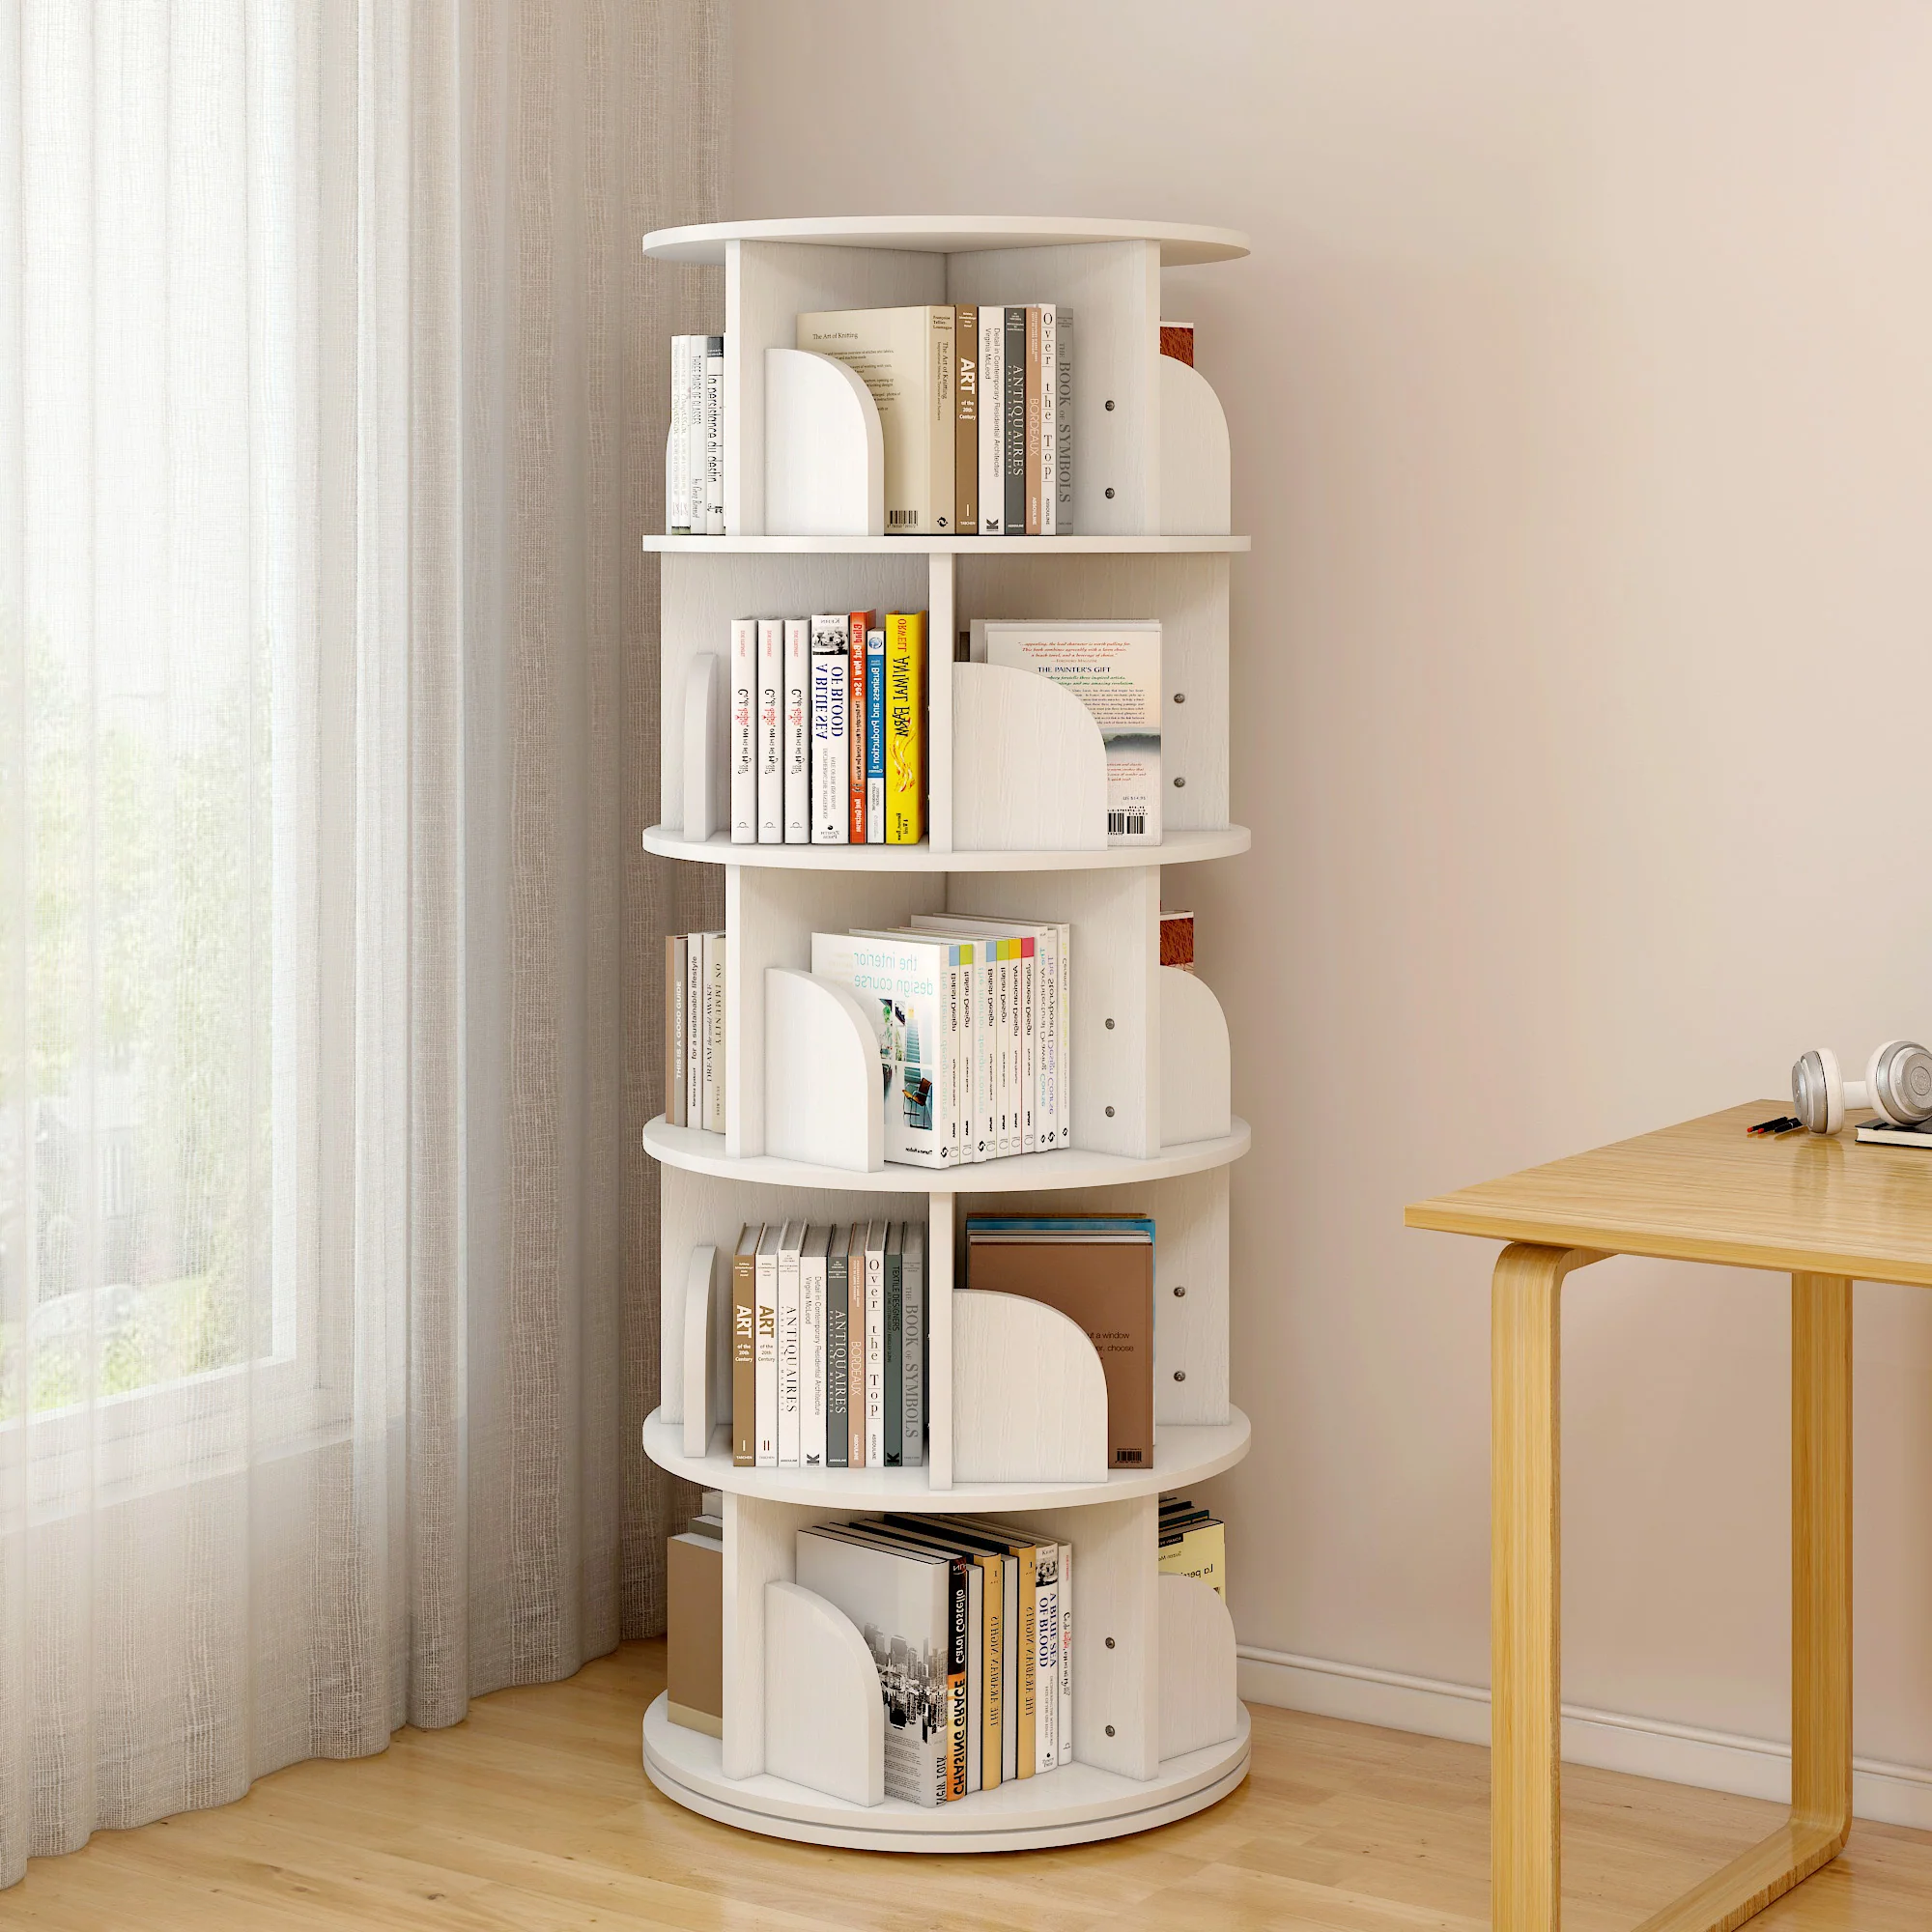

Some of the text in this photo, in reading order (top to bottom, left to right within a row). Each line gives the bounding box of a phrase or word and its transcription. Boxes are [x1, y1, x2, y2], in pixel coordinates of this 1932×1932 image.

[692, 355, 701, 373] THREE
[692, 374, 701, 390] PAIRS
[960, 357, 976, 394] ART
[1059, 362, 1071, 406] BOOK
[692, 400, 701, 425] GLASSES
[1010, 365, 1024, 476] ANTIQUAIRES
[1030, 398, 1039, 457] BORDEAUX
[707, 387, 724, 483] persistance du destin
[1059, 424, 1071, 502] SYMBOLS
[715, 963, 722, 978] ON
[676, 1039, 682, 1048] A
[676, 1049, 682, 1058] IS
[892, 1265, 900, 1332] TEXTILE DESIGNERS
[736, 1304, 753, 1339] ART
[759, 1305, 775, 1339] ART
[906, 1304, 919, 1347] BOOK
[784, 1306, 798, 1412] ANTIQUAIRES
[833, 1310, 846, 1414] ANTIQUAIRES
[851, 1341, 862, 1396] BORDEAUX
[906, 1363, 919, 1438] SYMBOLS
[1049, 1592, 1057, 1602] A
[1039, 1597, 1049, 1667] OF BLOOD
